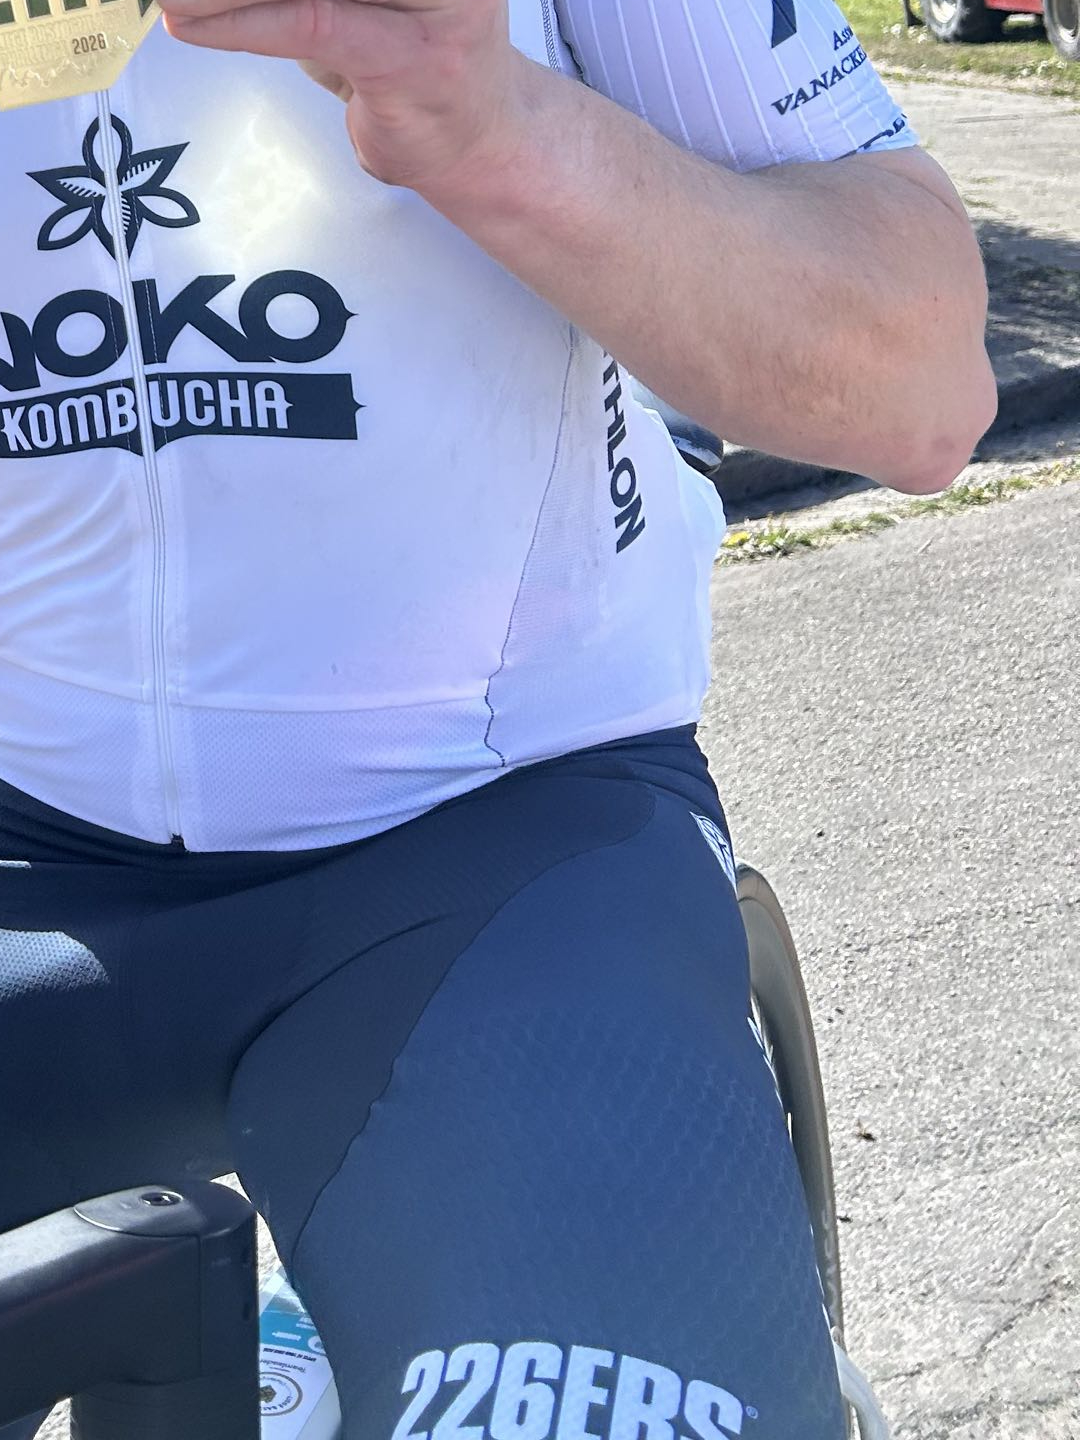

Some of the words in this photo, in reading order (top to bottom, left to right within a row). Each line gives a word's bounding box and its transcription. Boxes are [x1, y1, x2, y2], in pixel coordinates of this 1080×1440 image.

[72, 33, 107, 55] 2026
[0, 377, 294, 454] KOMBUCHA
[390, 1341, 744, 1440] 226ERS
